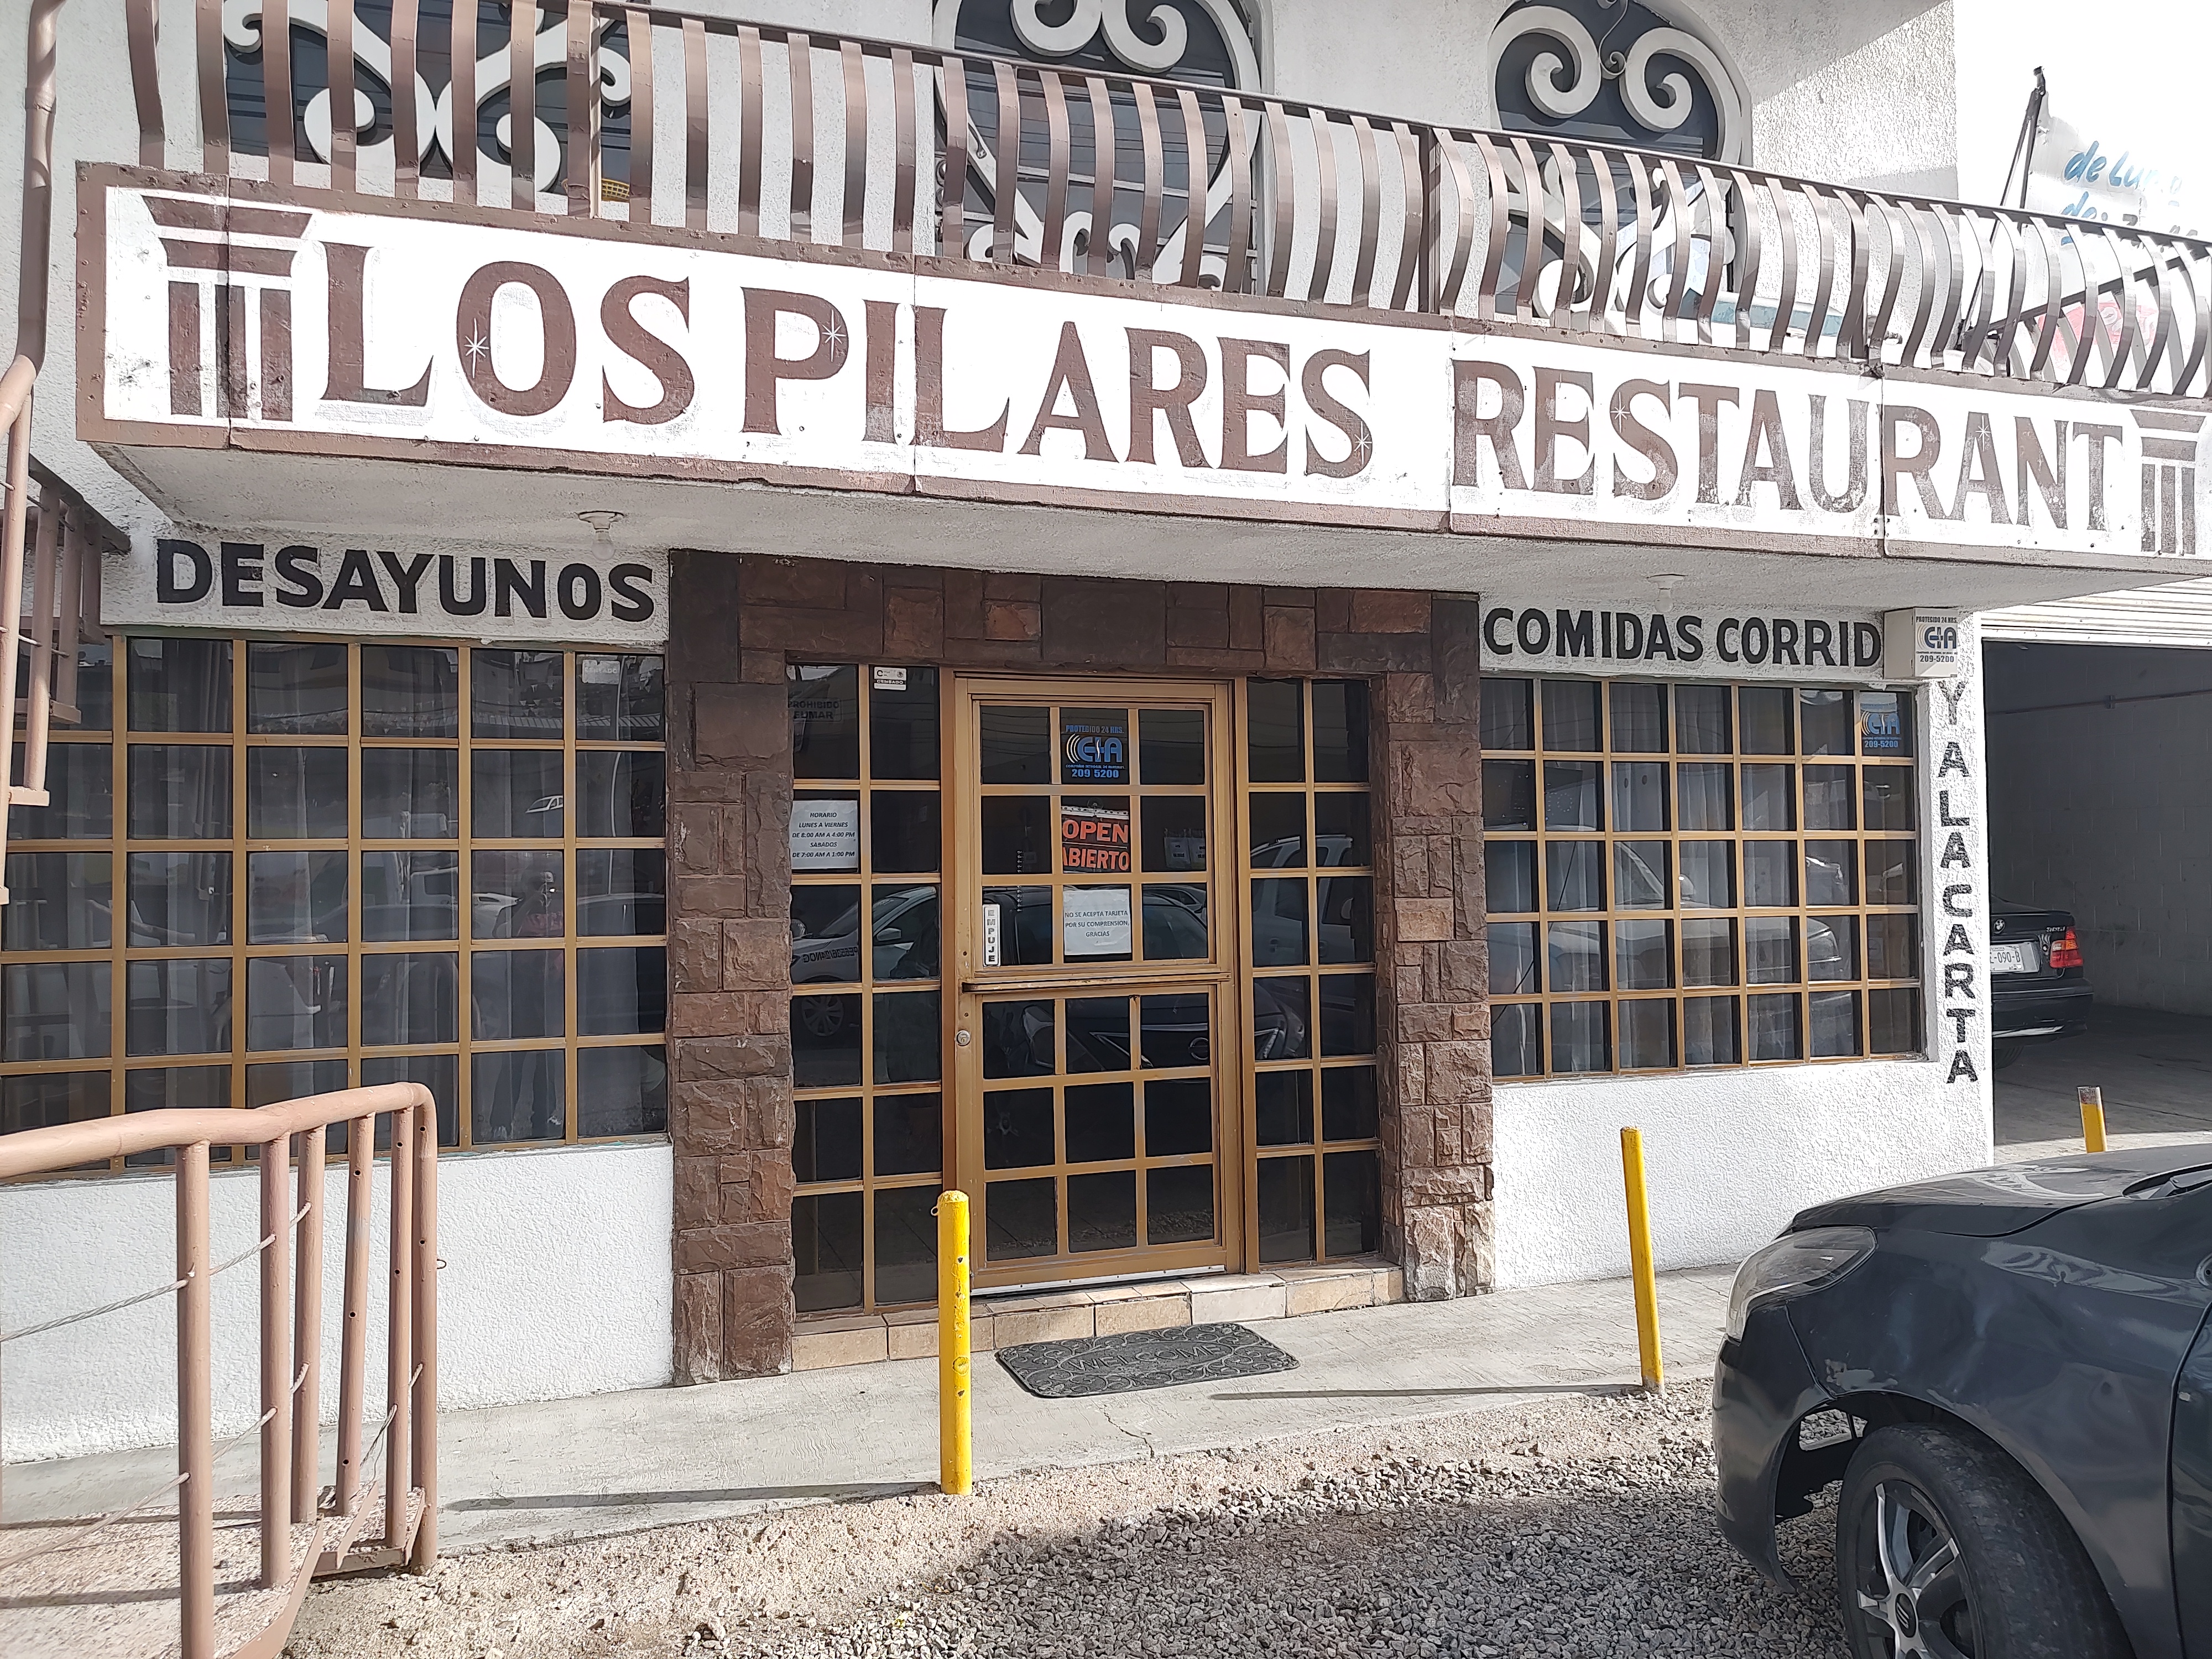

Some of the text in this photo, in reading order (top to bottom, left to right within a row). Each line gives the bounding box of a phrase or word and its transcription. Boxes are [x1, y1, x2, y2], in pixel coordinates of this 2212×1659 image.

[2064, 140, 2107, 183] de
[319, 241, 2124, 530] LOS PILARES RESTAURANT
[156, 538, 654, 623] DESAYUNOS
[1483, 608, 1881, 667] COMIDAS CORRID
[1924, 627, 1957, 649] CIA
[1867, 712, 1901, 735] CIA
[1077, 737, 1123, 763] CIA
[1071, 769, 1119, 778] 209 5200
[1062, 819, 1128, 843] OPEN
[1937, 681, 1979, 1084] Y A LA CARTA
[987, 909, 996, 962] EMPUJE
